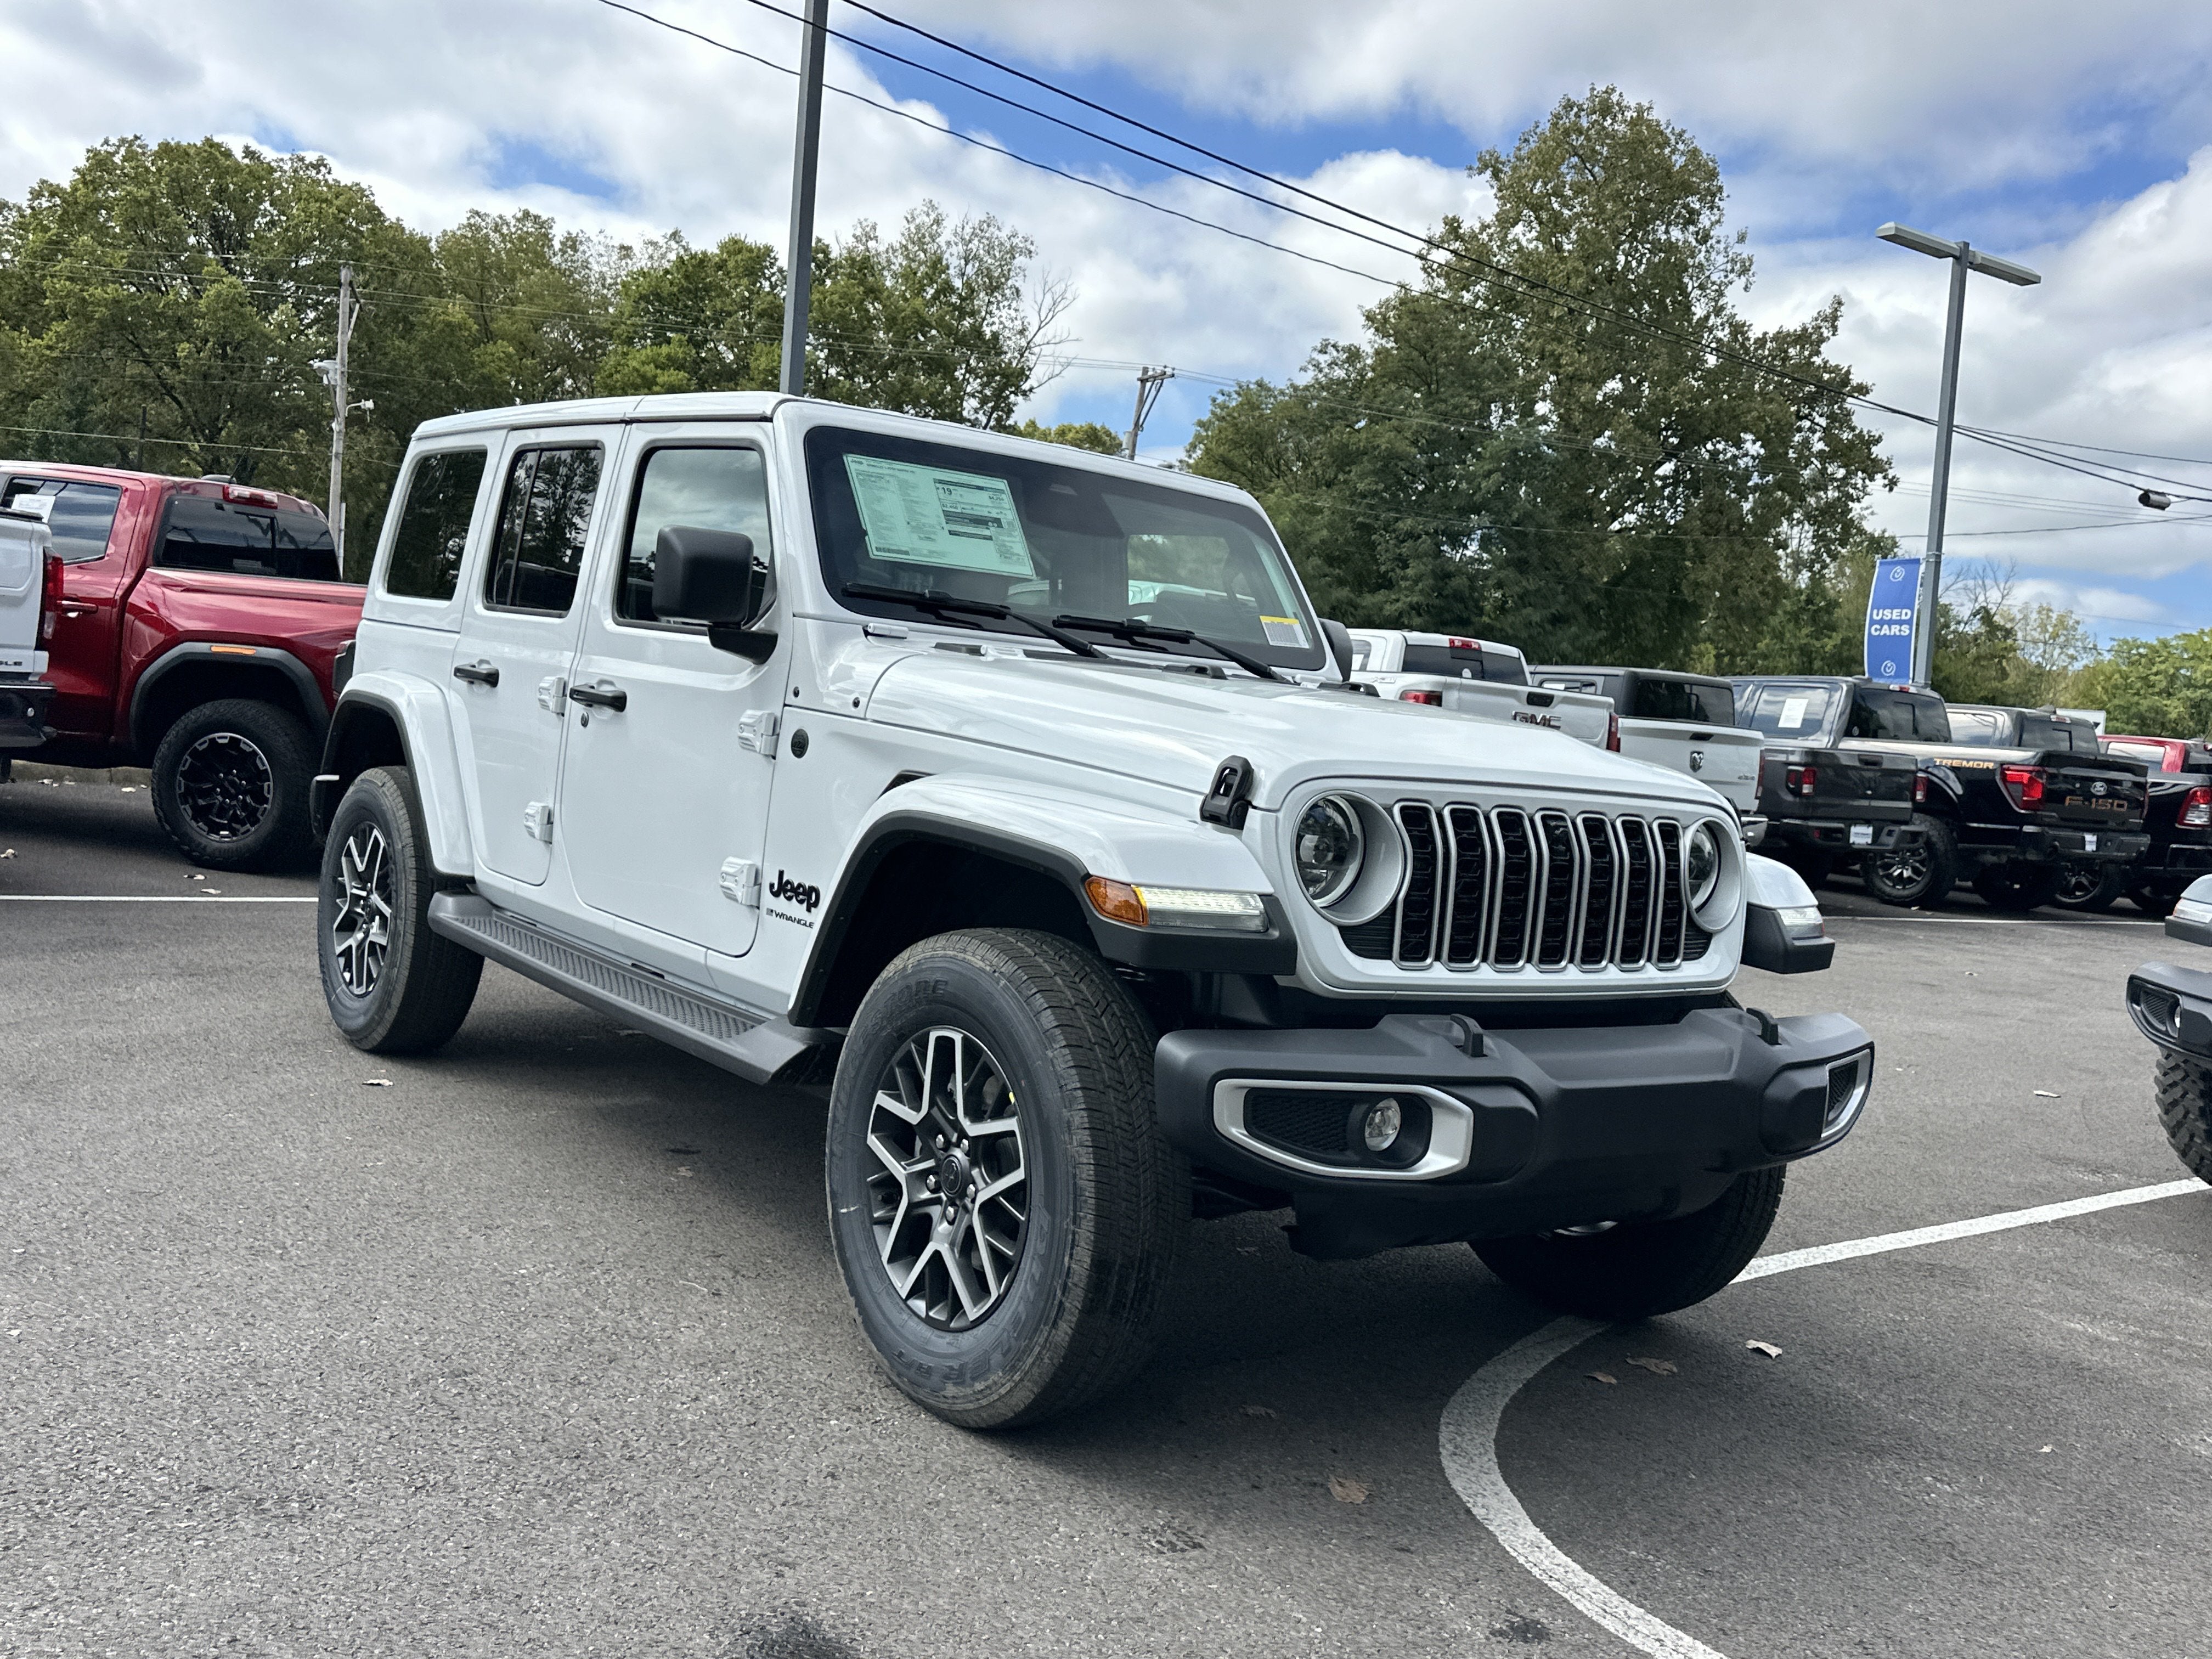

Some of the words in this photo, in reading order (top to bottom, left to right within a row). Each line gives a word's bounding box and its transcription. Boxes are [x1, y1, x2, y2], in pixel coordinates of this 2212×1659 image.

[941, 487, 952, 495] 19
[1872, 609, 1911, 620] USED
[1871, 624, 1910, 636] CARS
[1512, 710, 1562, 730] GMC
[1933, 758, 1995, 769] TREMOR
[2064, 795, 2128, 811] F-150
[769, 869, 821, 913] Jeep
